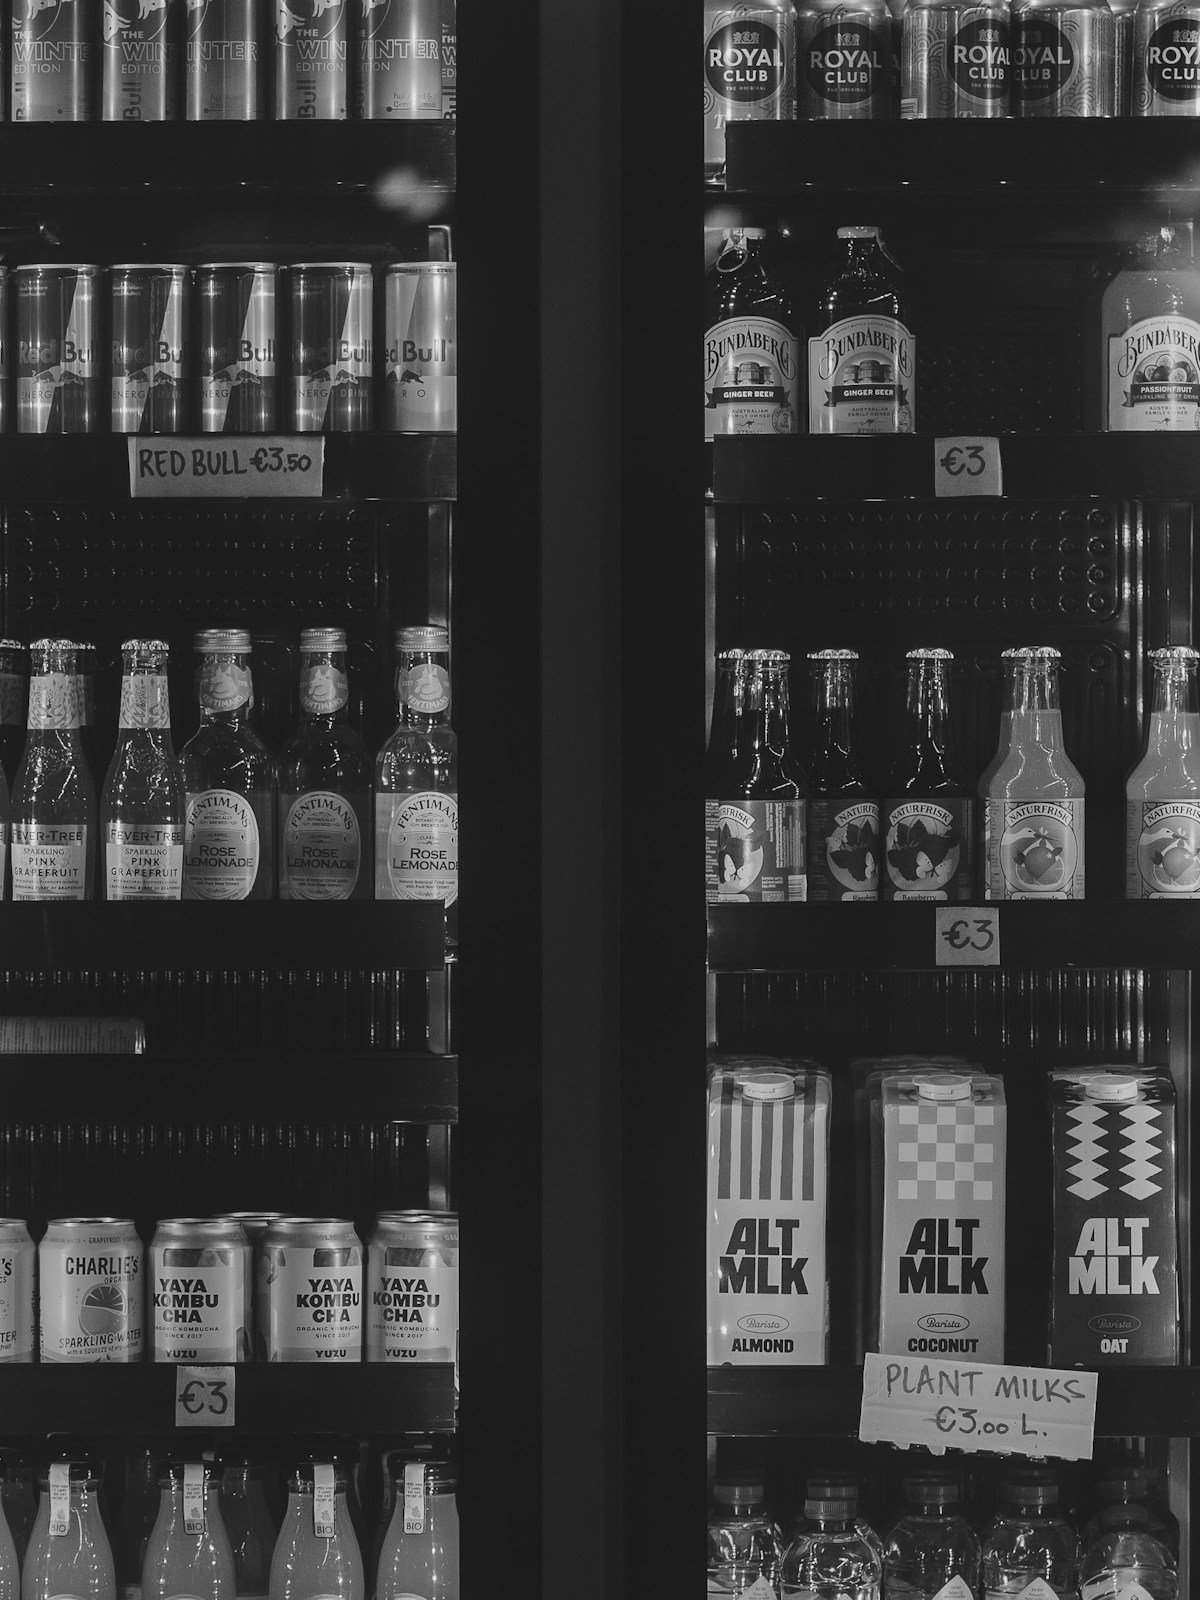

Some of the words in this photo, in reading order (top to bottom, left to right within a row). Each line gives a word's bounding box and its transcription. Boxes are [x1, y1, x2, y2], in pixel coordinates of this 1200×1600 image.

[14, 31, 34, 39] THE
[121, 31, 144, 39] THE
[296, 29, 319, 37] THE
[296, 40, 347, 60] WIN
[954, 45, 1011, 66] ROYAL
[709, 48, 784, 68] ROYAL
[809, 50, 882, 68] ROYAL
[14, 64, 61, 74] EDITION
[296, 62, 344, 72] EDITION
[968, 66, 1005, 80] CLUB
[1013, 67, 1051, 81] CLUB
[722, 70, 768, 83] CLUB
[824, 71, 869, 84] CLUB
[121, 81, 141, 120] Bull
[296, 80, 317, 119] Bull
[338, 339, 371, 362] Bull
[402, 340, 447, 363] Bull
[704, 329, 796, 382] BUNDABERG
[818, 327, 913, 381] BUNDABERG
[1117, 325, 1200, 378] BUNDABER
[723, 391, 753, 399] GINGER
[843, 389, 873, 397] GINGER
[139, 448, 186, 478] RED
[191, 448, 248, 477] BULL
[940, 445, 985, 476] €3
[188, 796, 249, 828] FENTIMANS
[290, 798, 351, 830] FENTIMANS
[891, 804, 949, 823] NATURFRISK
[1009, 805, 1070, 823] NATURFRISK
[110, 831, 182, 842] FEVER-TREE
[23, 848, 65, 856] SPARKLING
[124, 848, 168, 856] SPARKLING
[199, 845, 237, 857] ROSE
[302, 846, 340, 859] ROSE
[410, 847, 447, 860] ROSE
[28, 857, 57, 866] PINK
[131, 857, 160, 866] PINK
[184, 857, 255, 868] LEMONADE
[287, 857, 356, 869] LEMONADE
[13, 868, 79, 878] GRAPEFRUIT
[111, 868, 179, 878] GRAPEFRUIT
[941, 920, 994, 950] €3
[725, 1218, 800, 1256] ALT
[905, 1218, 980, 1256] ALT
[1074, 1217, 1150, 1256] ALT
[65, 1256, 139, 1276] CHARLIE'S
[719, 1256, 809, 1295] MLK
[899, 1256, 989, 1295] MLK
[1068, 1256, 1161, 1295] MLK
[159, 1278, 208, 1294] YAYA
[307, 1278, 354, 1294] YAYA
[380, 1277, 429, 1293] YAYA
[153, 1294, 219, 1308] KOMBU
[296, 1293, 360, 1308] KOMBU
[373, 1292, 440, 1308] KOMBU
[162, 1309, 203, 1324] CHA
[311, 1309, 351, 1323] CHA
[382, 1308, 423, 1324] CHA
[745, 1317, 781, 1330] Barista
[926, 1317, 961, 1330] Barista
[1096, 1318, 1132, 1330] Barista
[59, 1333, 114, 1350] SPARKLING
[116, 1328, 142, 1342] WATER
[731, 1338, 795, 1354] ALMOND
[907, 1338, 979, 1354] COCONUT
[1100, 1338, 1129, 1354] OAT
[84, 1346, 108, 1354] SQUEEZE
[166, 1350, 197, 1359] YUZU
[315, 1350, 347, 1359] YUZU
[385, 1349, 418, 1359] YUZU
[886, 1363, 984, 1397] PLANT
[994, 1375, 1086, 1403] MILKS
[177, 1380, 228, 1415] €3
[186, 1522, 203, 1531] BIO
[316, 1526, 333, 1534] BIO
[406, 1522, 422, 1531] BIO
